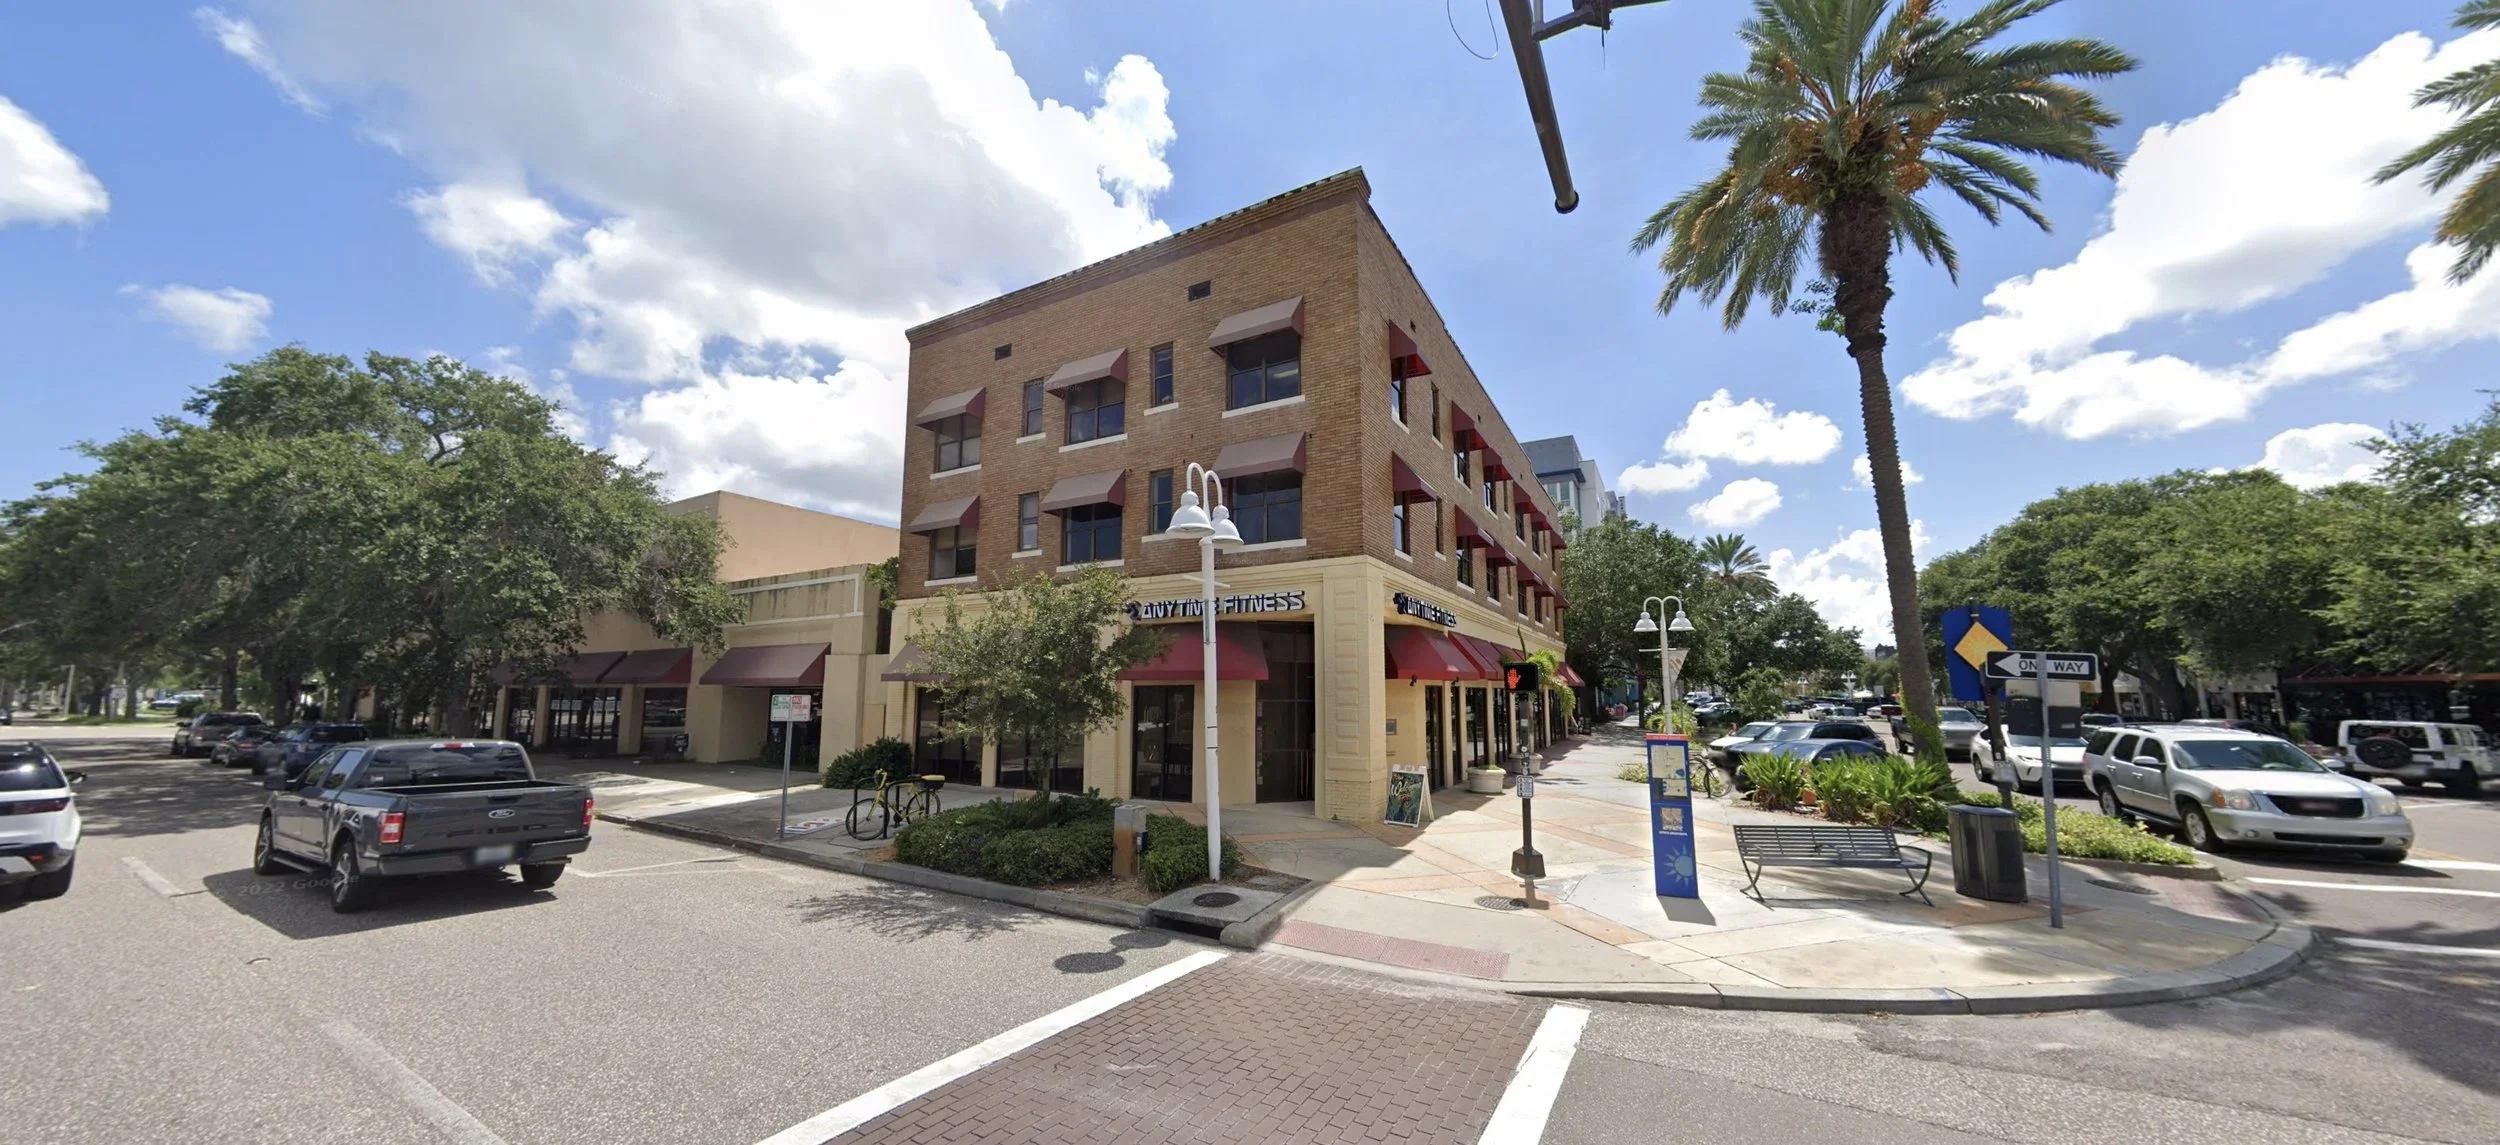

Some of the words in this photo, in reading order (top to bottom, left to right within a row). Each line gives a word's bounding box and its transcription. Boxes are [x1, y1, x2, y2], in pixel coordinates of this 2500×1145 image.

[1141, 599, 1216, 618] ANYTIM
[1224, 591, 1303, 614] FITNESS
[2019, 660, 2042, 671] ON
[2053, 661, 2084, 672] WAY
